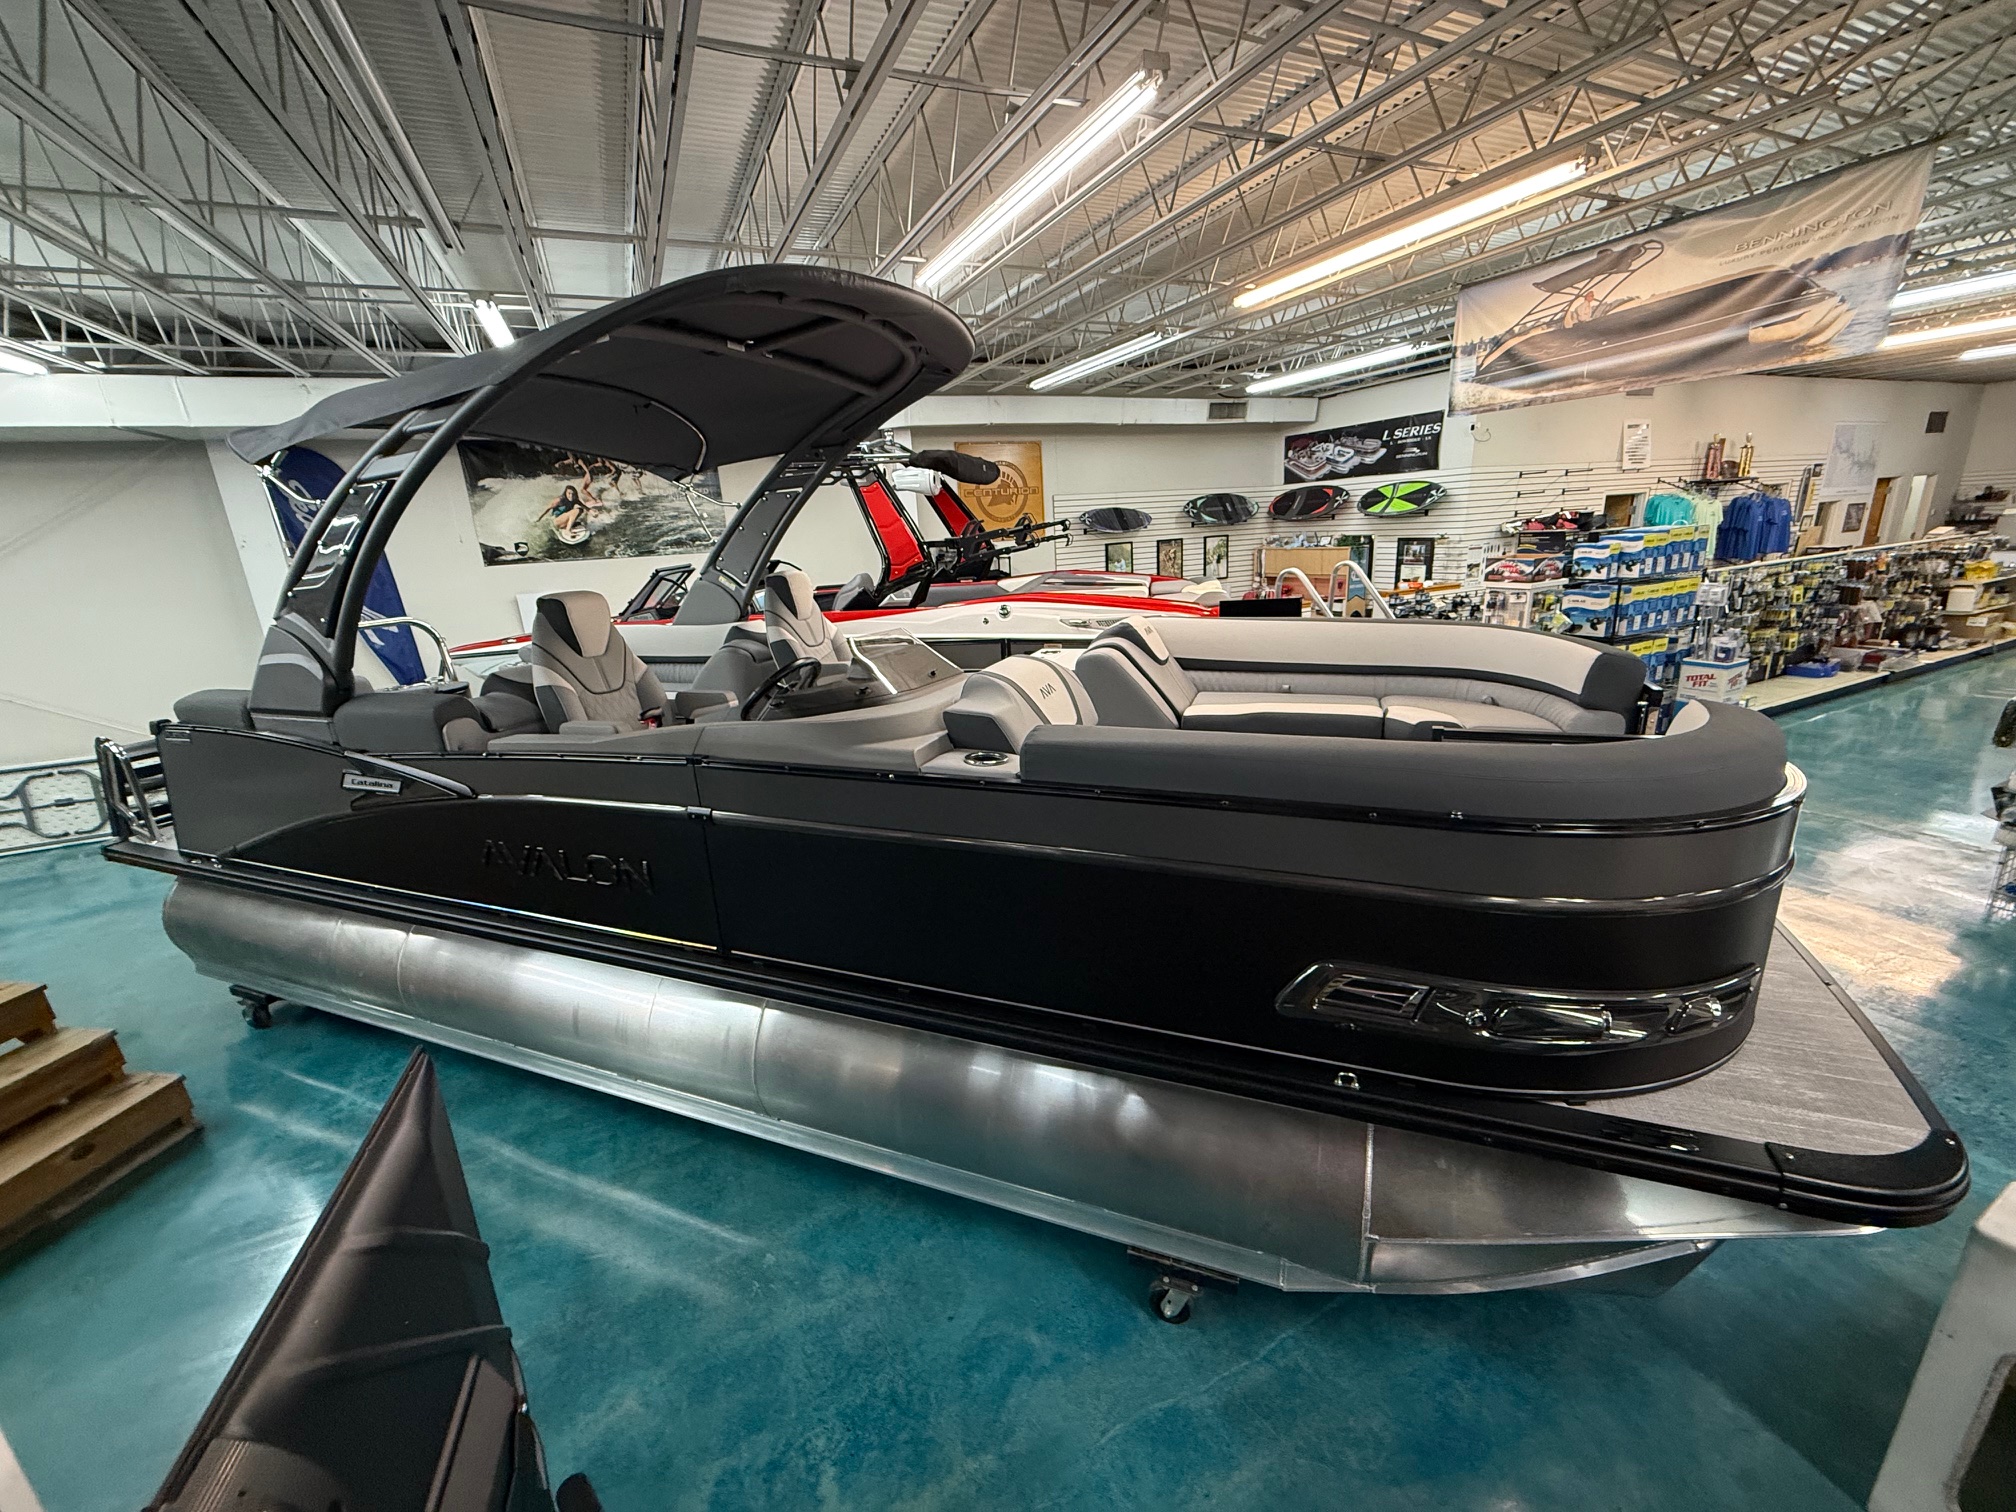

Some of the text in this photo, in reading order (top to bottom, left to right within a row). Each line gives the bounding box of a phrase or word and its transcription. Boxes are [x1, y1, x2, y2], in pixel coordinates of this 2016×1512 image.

[1735, 201, 1892, 252] BENNINGTON
[1382, 430, 1390, 441] L
[1393, 423, 1442, 439] SERIES
[964, 486, 1039, 498] CENTURION
[1685, 673, 1717, 682] TOTAL
[1692, 680, 1708, 688] FIT
[1039, 683, 1057, 700] AVA
[351, 778, 393, 788] Catalina
[481, 839, 656, 894] AVALON
